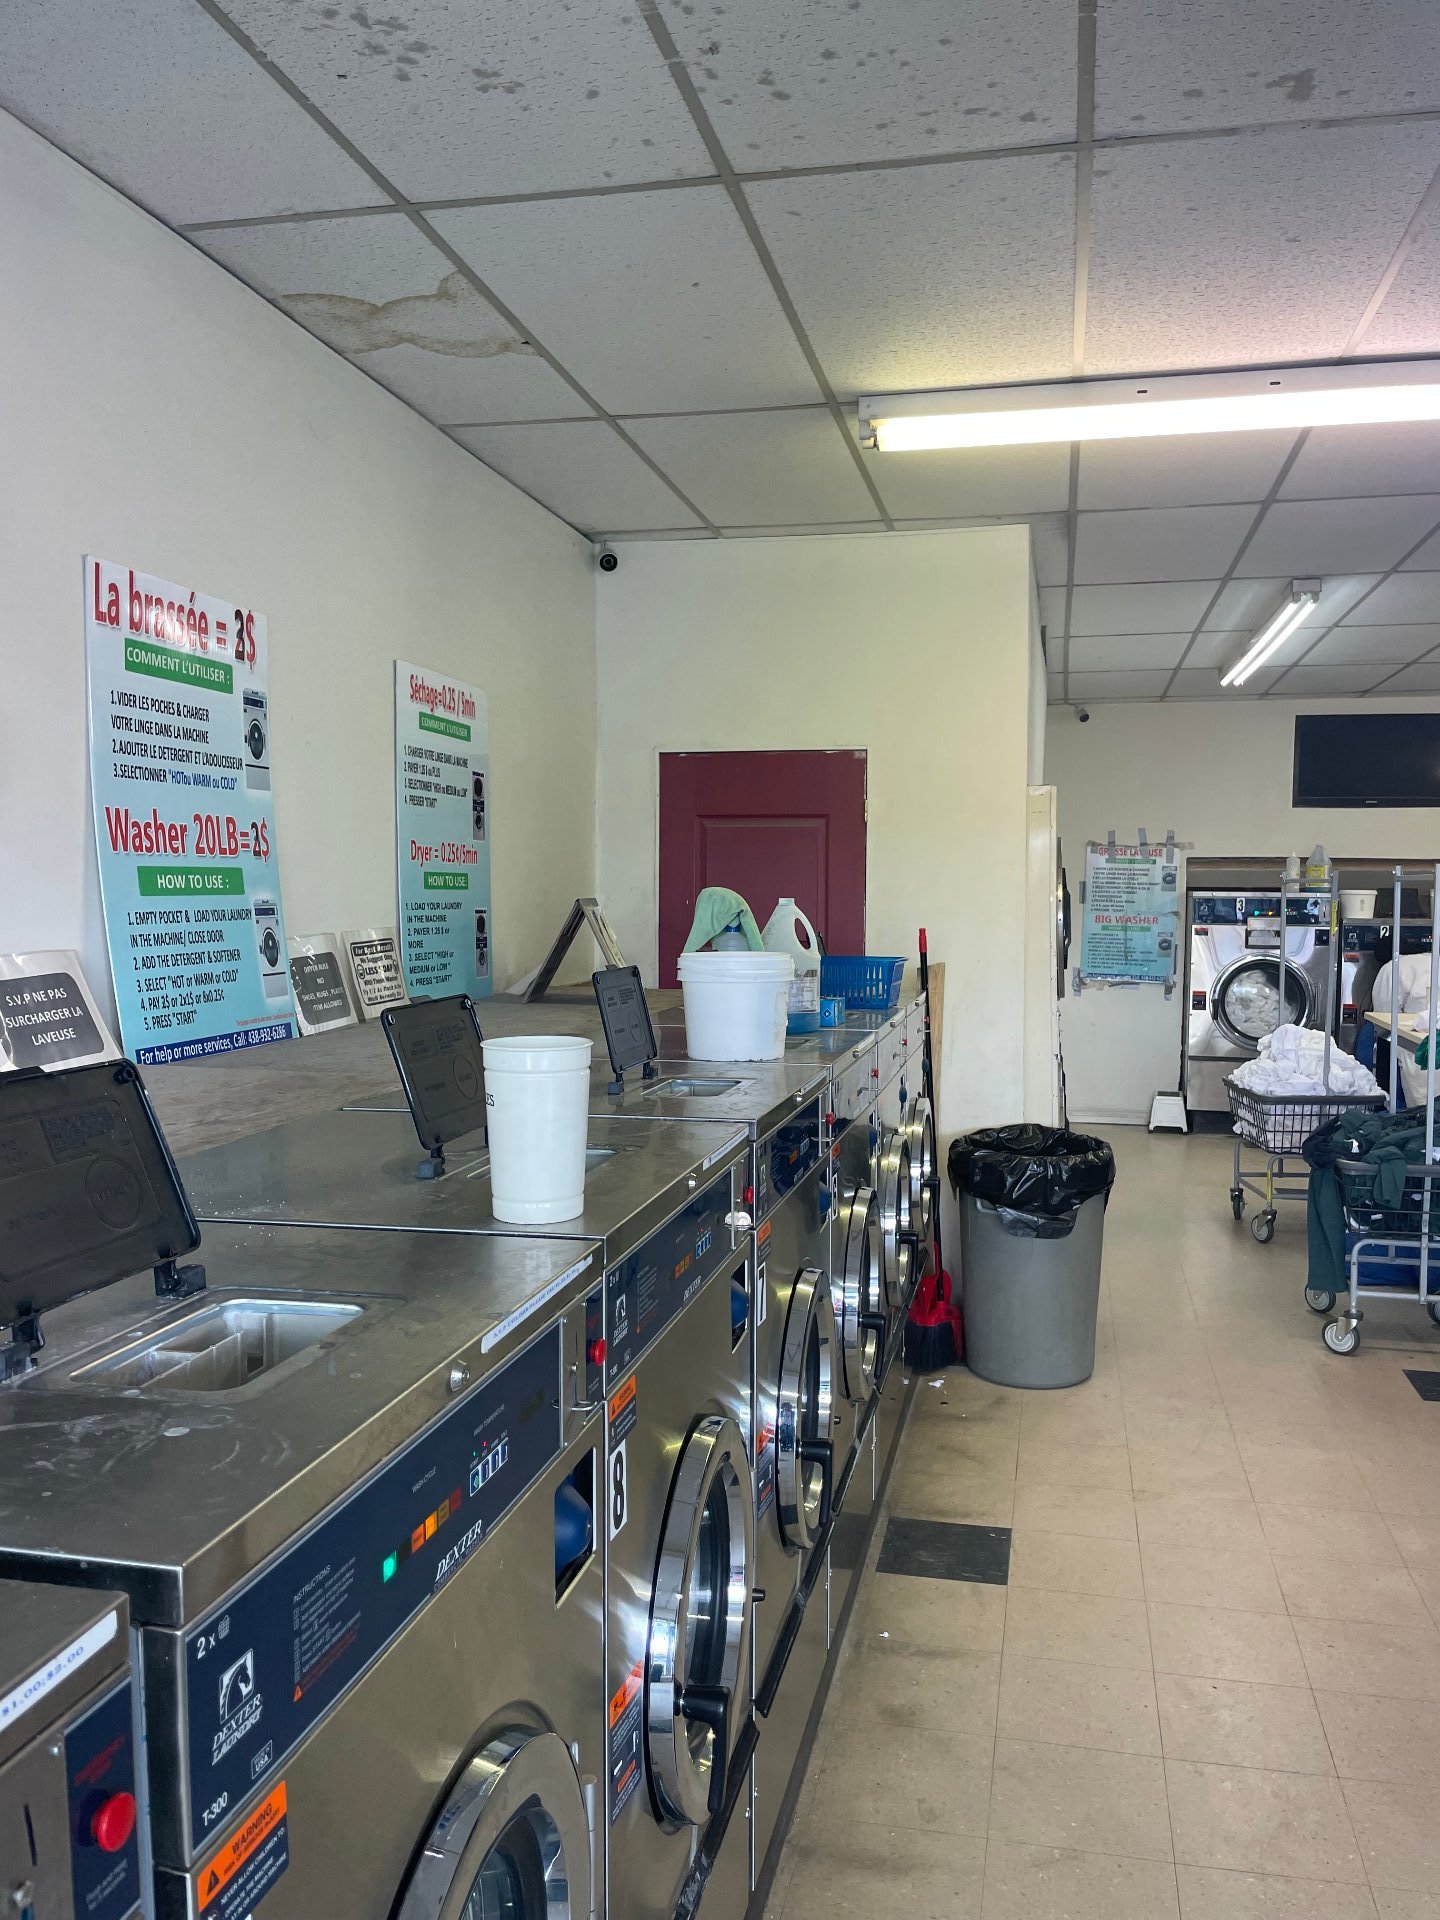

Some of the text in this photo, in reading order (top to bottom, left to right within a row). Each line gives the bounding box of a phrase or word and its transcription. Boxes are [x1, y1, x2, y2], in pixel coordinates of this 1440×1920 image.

[94, 561, 257, 671] La brassée = 2$
[126, 647, 225, 683] COMMENT L'UTILISER
[138, 695, 150, 710] LES
[150, 698, 175, 716] POCHES
[176, 703, 182, 716] &
[182, 704, 210, 722] CHARGER
[110, 714, 210, 744] VOTRE LINGE DANS LA MACHINE
[422, 718, 446, 731] COMMENT
[150, 744, 156, 759] LE
[158, 746, 193, 764] DETERGENT
[194, 750, 201, 764] ET
[192, 772, 211, 788] WARM
[212, 778, 220, 788] ou
[220, 776, 238, 790] COLD"
[105, 806, 188, 856] Washer
[410, 840, 432, 868] Dryer
[434, 848, 438, 858] =
[1098, 848, 1128, 856] GRSSE
[158, 875, 223, 888] HOW TO USE
[428, 876, 444, 886] HOW
[446, 876, 454, 886] TO
[411, 902, 426, 910] LOAD
[426, 902, 440, 910] YOUR
[441, 902, 462, 910] LAUNDRY
[1238, 899, 1244, 912] 3
[128, 908, 252, 926] 1. EMPTY POCKET & LOAD YOUR LAUNDRY
[414, 915, 424, 923] THE
[425, 914, 447, 922] MACHINE
[1095, 915, 1158, 924] BIG WASHER
[130, 934, 138, 948] IN
[138, 933, 152, 948] THE
[188, 930, 206, 944] CLOSE
[207, 930, 224, 942] DOOR
[414, 928, 430, 936] PAYER
[1382, 926, 1388, 938] 2
[408, 940, 424, 948] MORE
[134, 948, 241, 970] 2. ADD THE DETERGENT & SOFTENER
[414, 952, 434, 961] SELECT
[365, 966, 378, 976] LESS
[410, 965, 430, 974] MEDIUM
[136, 968, 239, 992] 3. SELECT "HOT or WARM or COLD"
[416, 977, 432, 986] PRESS
[6, 988, 68, 1006] S.V.P NE PAS
[140, 998, 148, 1012] 4.
[148, 996, 160, 1010] PAY
[172, 997, 178, 1008] or
[195, 994, 202, 1004] or
[6, 1006, 84, 1028] SURCHARGER LA
[144, 1010, 197, 1030] 5. PRESS "START"
[32, 1028, 76, 1046] LAVEUSE
[140, 1050, 154, 1064] For
[154, 1046, 172, 1064] help
[174, 1048, 182, 1058] or
[184, 1044, 202, 1057] more
[204, 1036, 233, 1052] services,
[234, 1032, 248, 1048] Call:
[758, 1267, 764, 1323] 7
[614, 1450, 624, 1530] 8
[435, 1519, 482, 1582] DEXTER
[294, 1564, 330, 1604] INSTRUCTIONS
[198, 1637, 206, 1660] 2
[213, 1694, 261, 1750] DEXTER
[212, 1706, 262, 1766] LAUNDRY
[256, 1754, 268, 1772] USA
[202, 1792, 228, 1826] T-300
[232, 1803, 272, 1854] WARNING
[220, 1837, 278, 1905] NEVER ALLOW CHILDREN
[246, 1879, 254, 1892] THE
[254, 1856, 274, 1880] MACHINE
[268, 1852, 286, 1879] MACHINE
